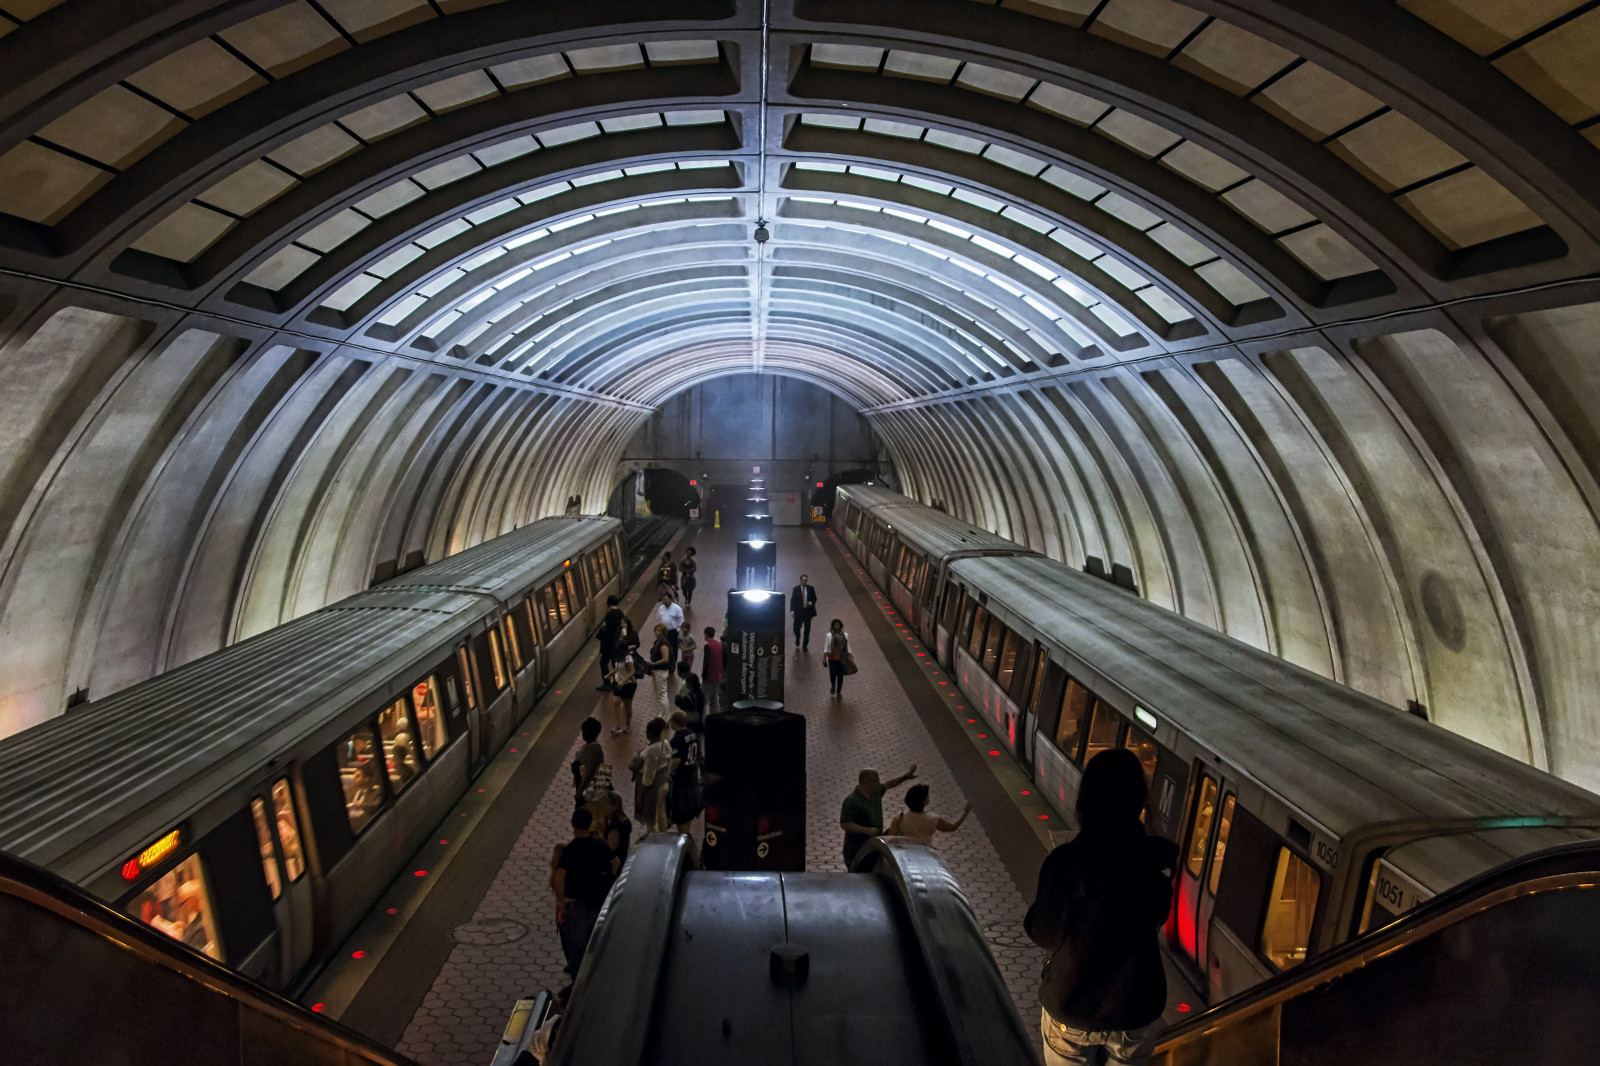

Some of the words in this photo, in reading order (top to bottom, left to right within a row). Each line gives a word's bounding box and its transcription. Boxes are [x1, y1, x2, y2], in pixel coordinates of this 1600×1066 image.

[748, 631, 756, 669] Woodley
[740, 662, 748, 694] Morgan
[1317, 841, 1339, 868] 1050
[1378, 877, 1403, 908] 1051
